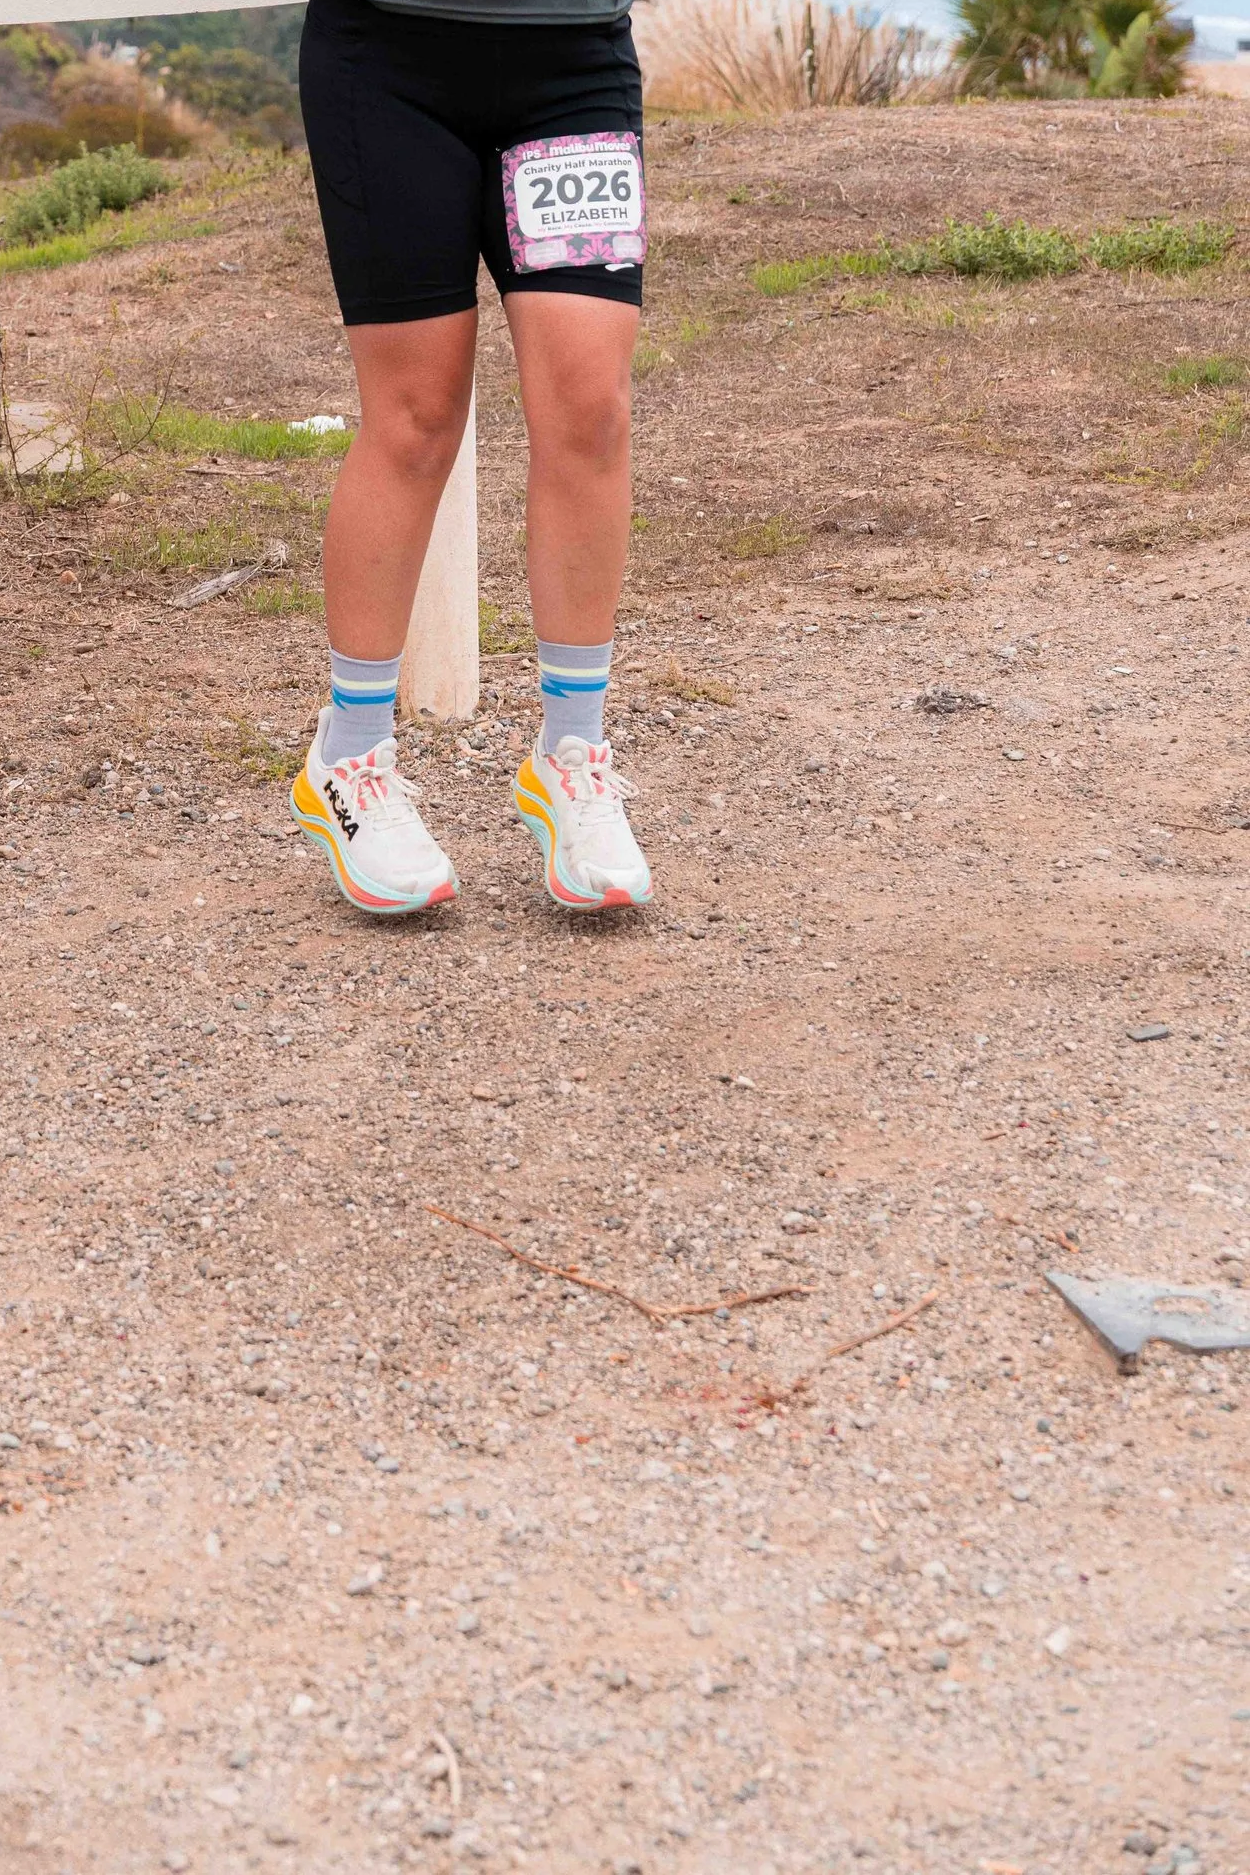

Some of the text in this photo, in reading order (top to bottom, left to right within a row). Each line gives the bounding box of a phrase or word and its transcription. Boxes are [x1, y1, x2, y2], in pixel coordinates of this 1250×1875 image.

[522, 148, 542, 161] IPS
[523, 157, 633, 176] Charity Half Marathon
[528, 170, 632, 210] 2026
[541, 206, 629, 226] ELIZABETH
[323, 778, 360, 843] HOKA
